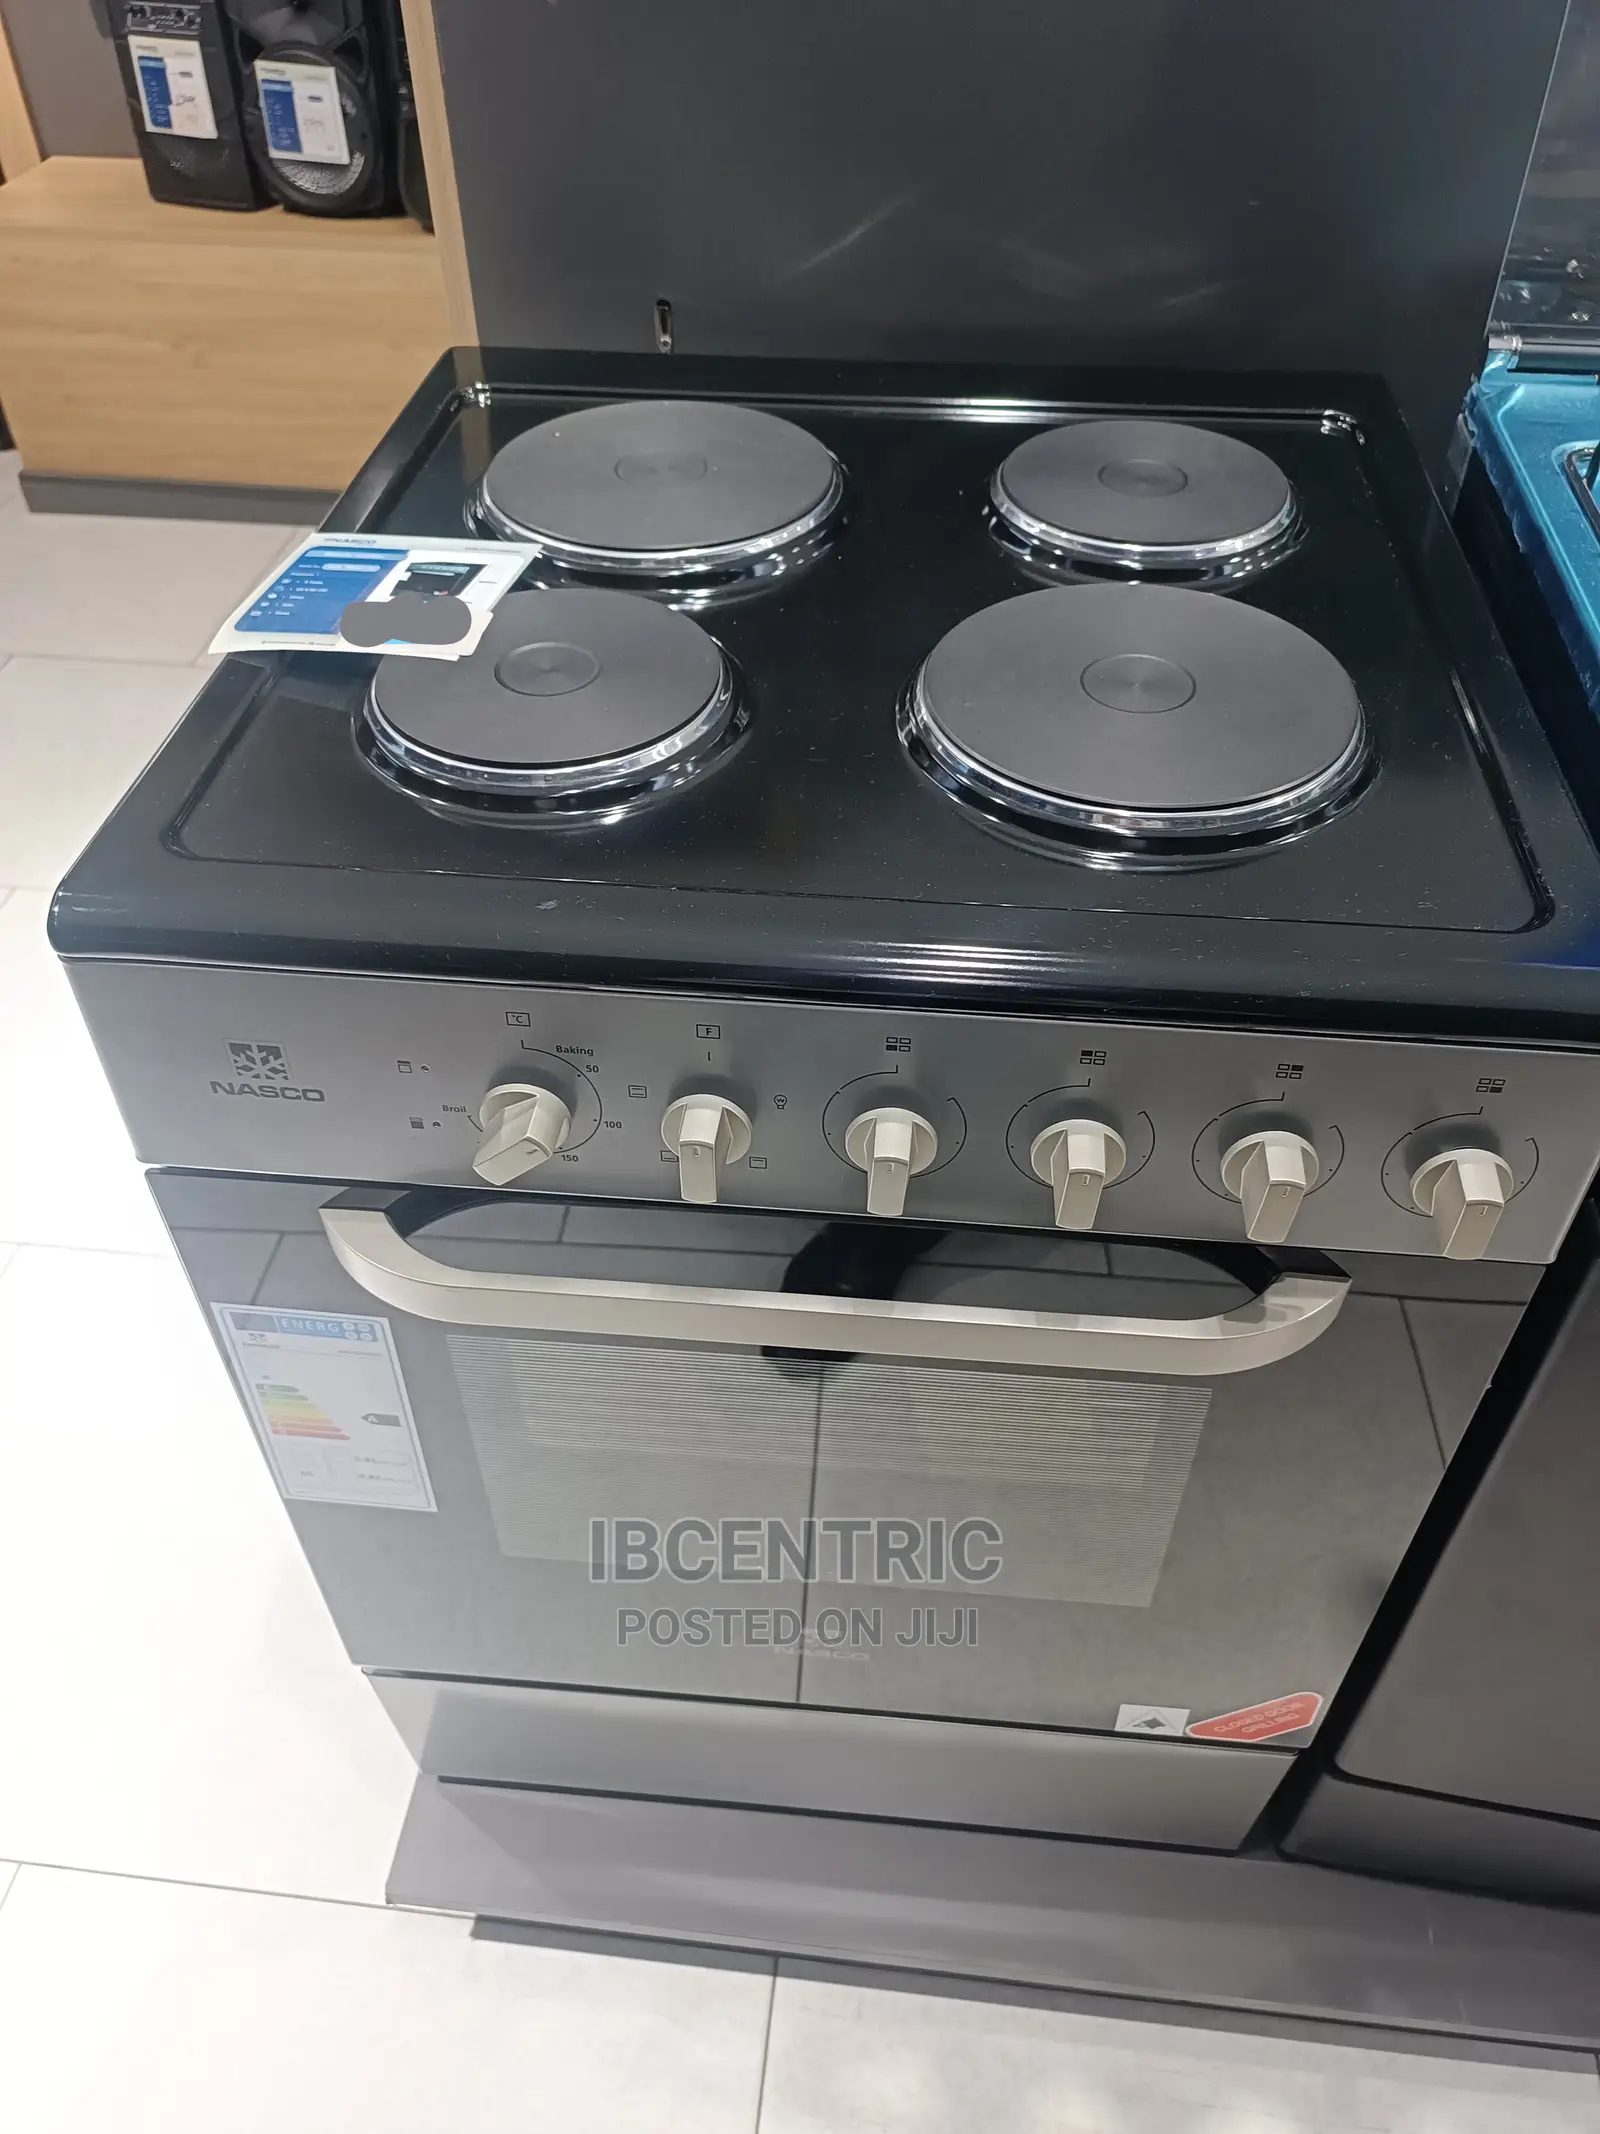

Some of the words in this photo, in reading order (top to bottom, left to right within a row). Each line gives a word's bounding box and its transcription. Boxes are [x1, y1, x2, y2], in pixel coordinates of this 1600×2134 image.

[705, 1027, 712, 1036] F
[555, 1045, 594, 1057] Baking
[585, 1064, 600, 1073] 50
[209, 1080, 326, 1102] NASCO
[442, 1104, 467, 1113] Broil
[603, 1120, 623, 1129] 100
[561, 1154, 579, 1163] 150
[281, 1318, 340, 1333] ENERG
